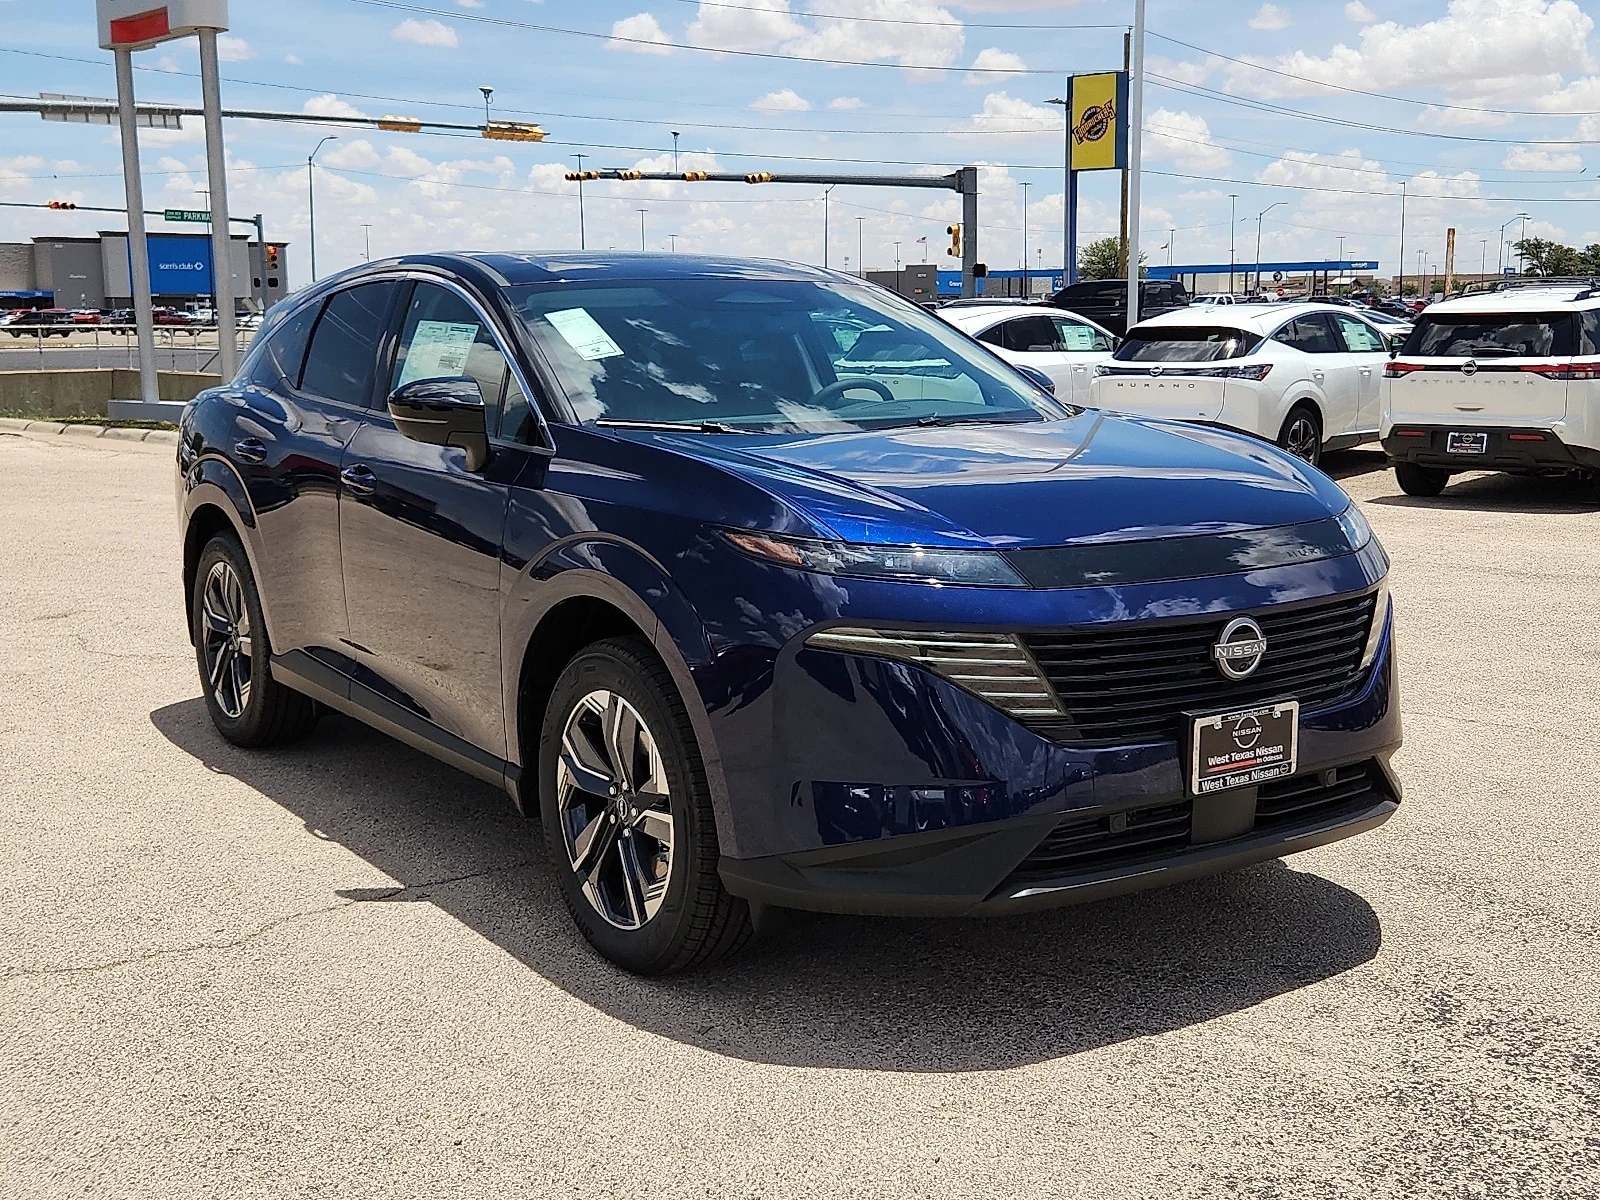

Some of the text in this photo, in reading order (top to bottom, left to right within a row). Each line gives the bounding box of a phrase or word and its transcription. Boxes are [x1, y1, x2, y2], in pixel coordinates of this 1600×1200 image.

[1216, 640, 1266, 658] NISSAN
[1232, 726, 1262, 737] NISSAN
[1207, 744, 1284, 766] West Texas Nissan
[1262, 753, 1284, 763] Odessa
[1201, 767, 1279, 791] West Texas Nissan
